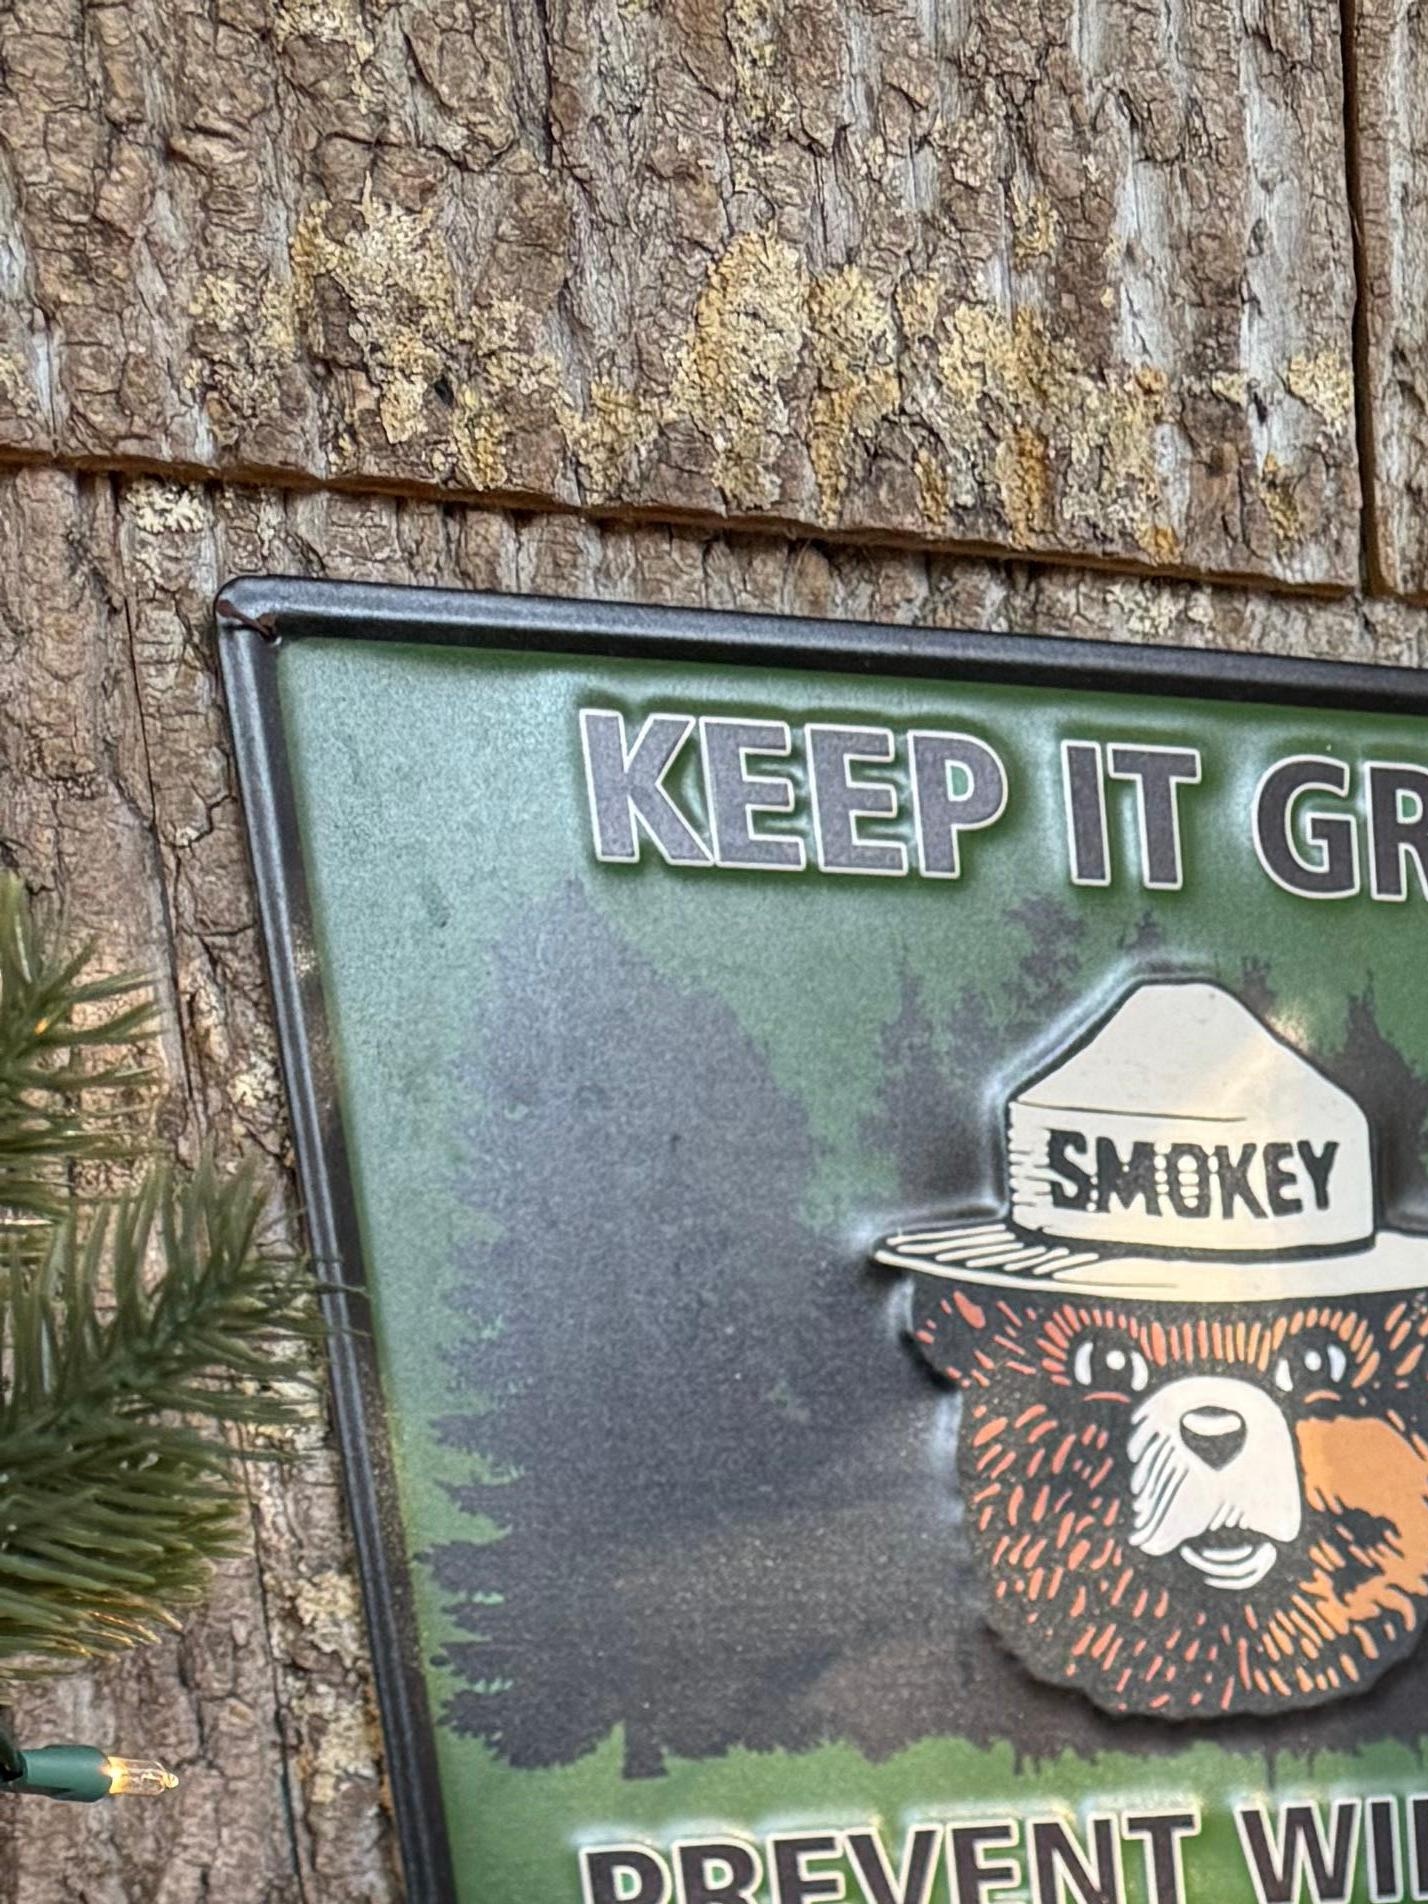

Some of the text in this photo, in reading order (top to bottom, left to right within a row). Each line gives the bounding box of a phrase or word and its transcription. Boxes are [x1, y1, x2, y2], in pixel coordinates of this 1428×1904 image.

[578, 709, 1007, 878] KEEP
[1060, 740, 1201, 890] IT
[1048, 1128, 1339, 1220] SMOKEY
